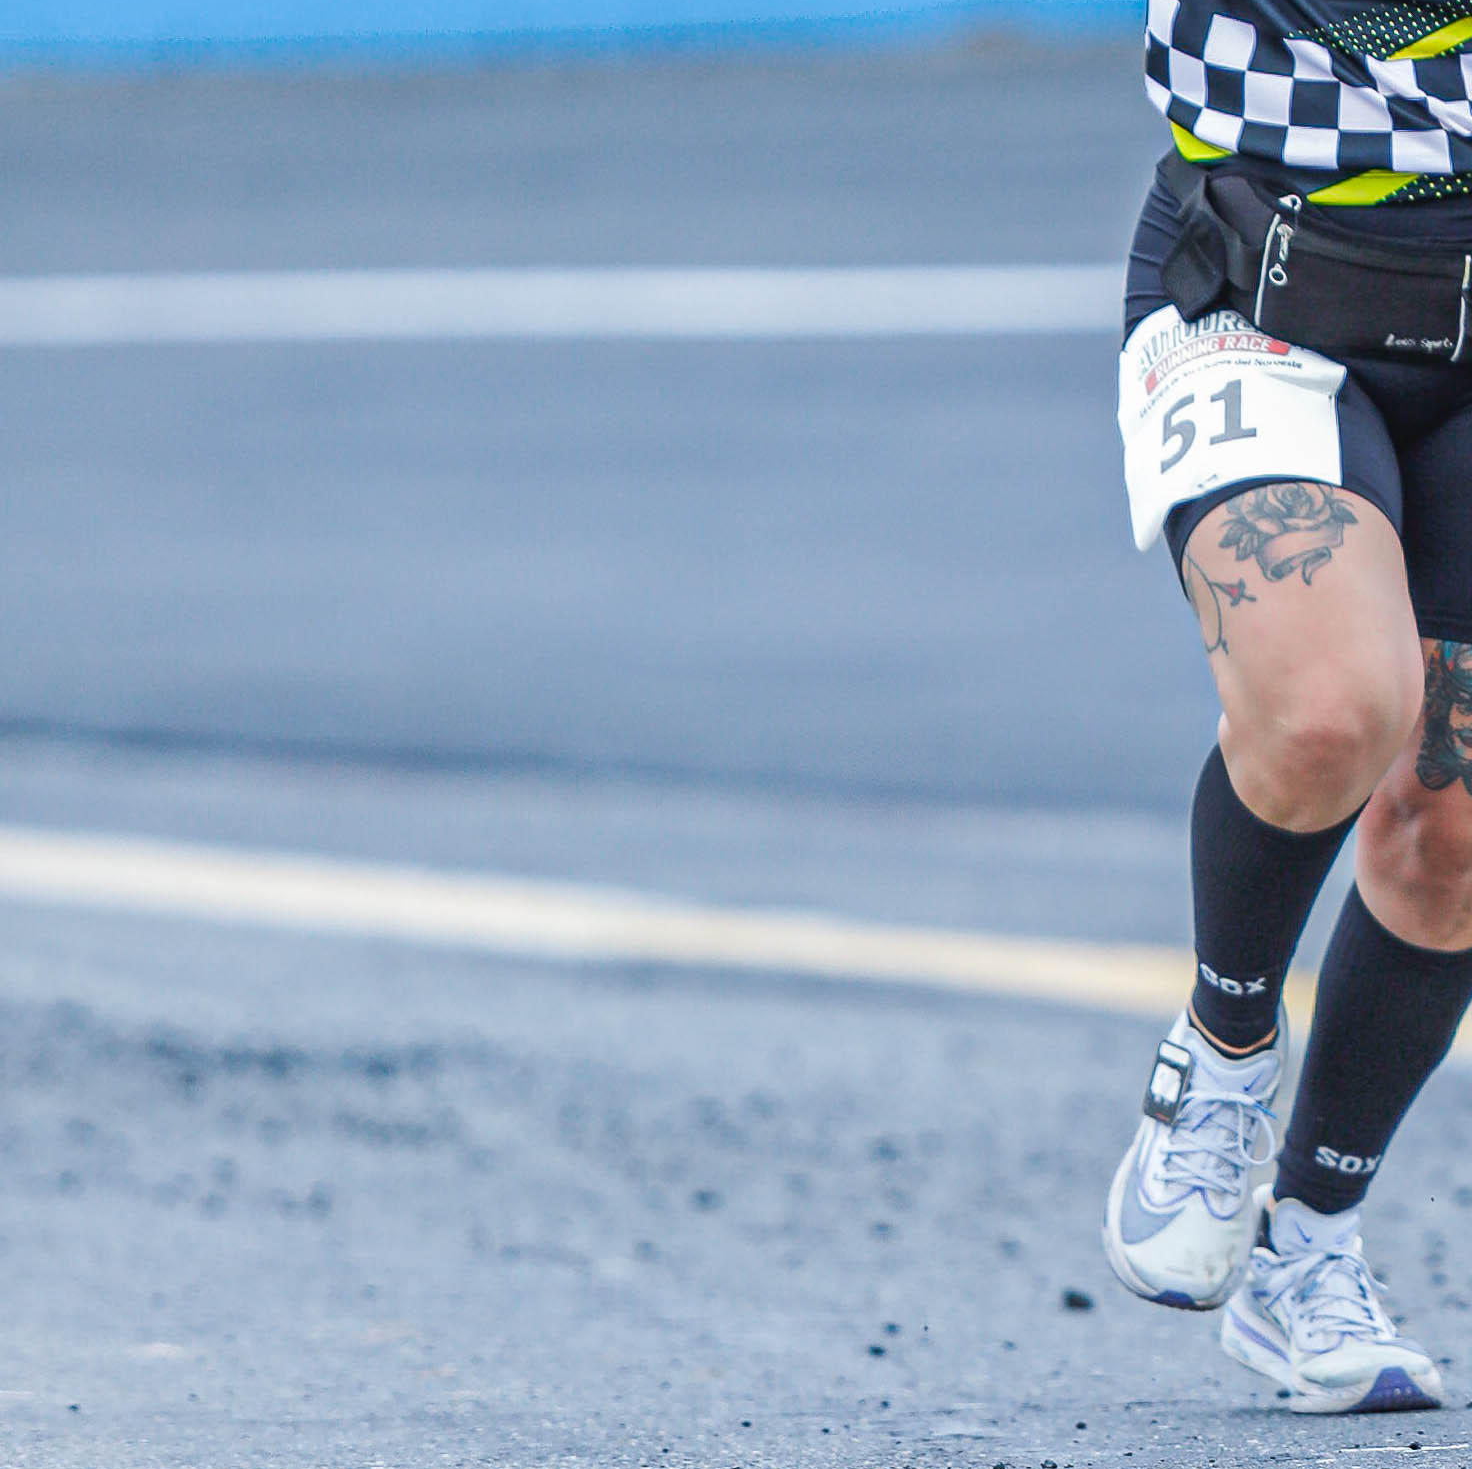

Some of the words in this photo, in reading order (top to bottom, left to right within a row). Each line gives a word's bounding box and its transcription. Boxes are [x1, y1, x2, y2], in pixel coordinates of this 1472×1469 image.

[1154, 336, 1220, 383] RUNNING
[1223, 334, 1272, 352] RACE
[1158, 378, 1258, 475] 51
